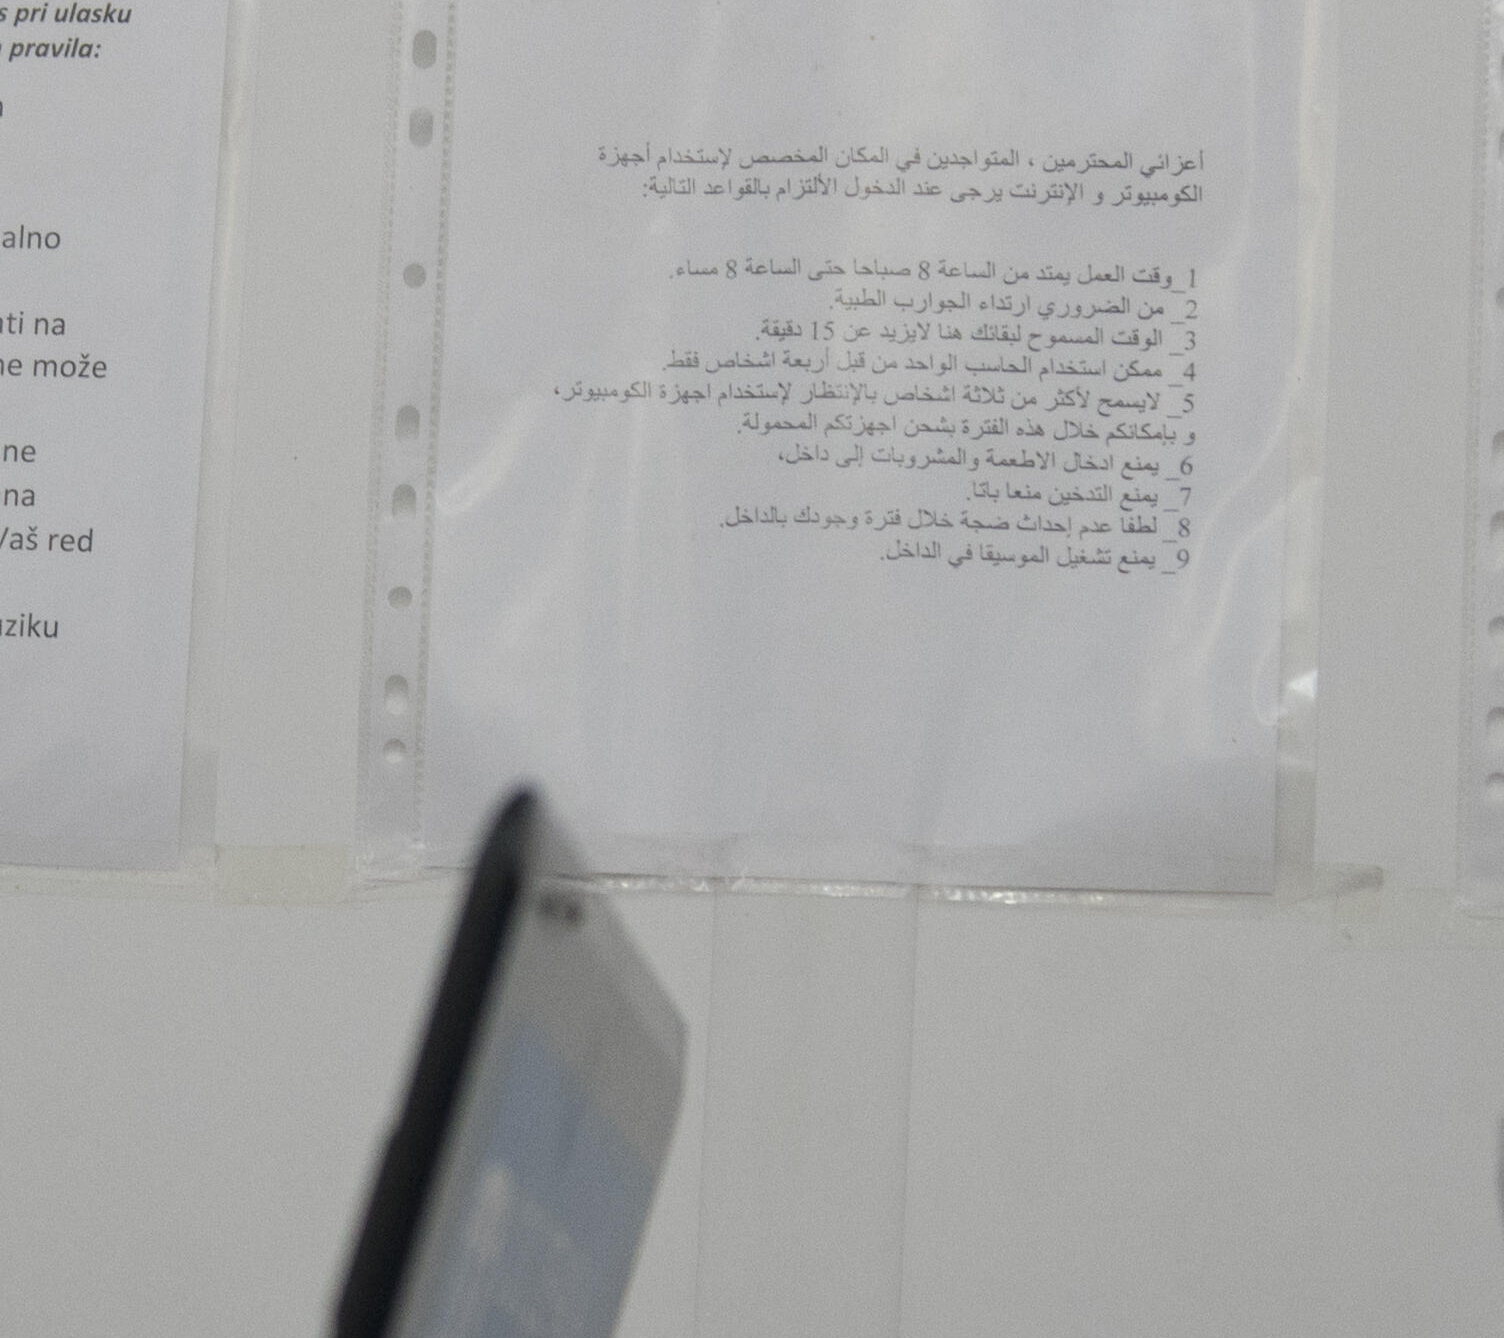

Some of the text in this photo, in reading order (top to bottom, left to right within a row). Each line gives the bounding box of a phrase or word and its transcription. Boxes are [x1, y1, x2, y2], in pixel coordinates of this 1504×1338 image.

[14, 1, 49, 29] pri
[53, 0, 134, 26] ulasku
[9, 35, 103, 65] pravila:
[32, 315, 67, 337] na
[31, 351, 109, 380] može
[46, 526, 95, 553] red
